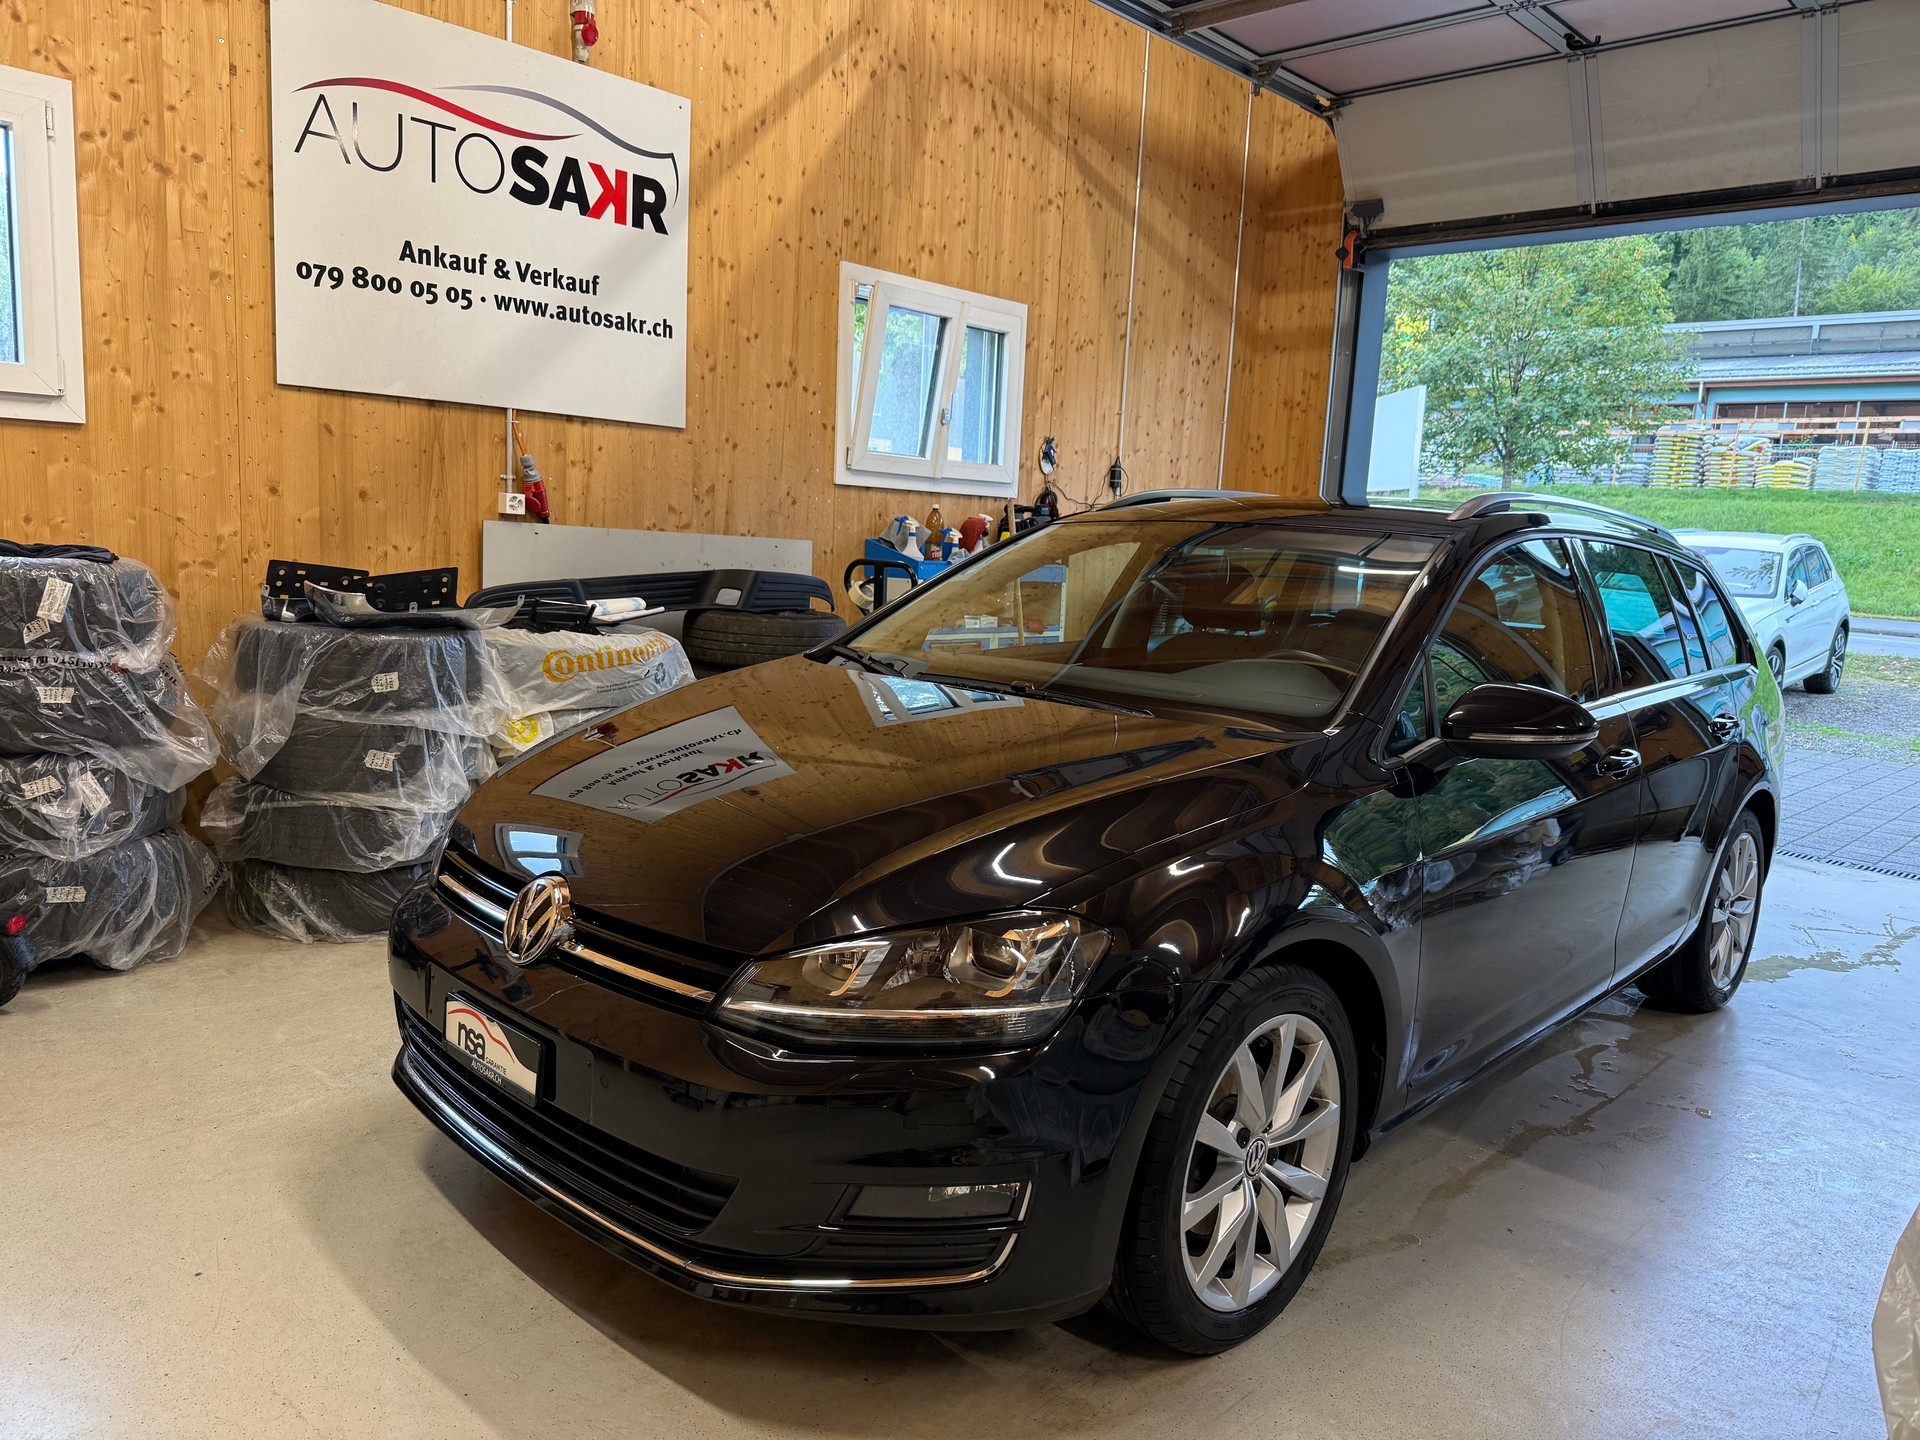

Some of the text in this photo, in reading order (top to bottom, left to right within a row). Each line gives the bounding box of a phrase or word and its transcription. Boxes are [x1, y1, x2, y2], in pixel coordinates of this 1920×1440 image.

[294, 93, 669, 236] AUTOSAKR
[399, 239, 601, 297] Ankauf & Verkauf
[295, 261, 345, 290] 079
[351, 266, 403, 295] 800
[409, 280, 439, 305] 05
[445, 286, 473, 311] 05
[493, 294, 673, 340] www.autosakr.ch
[541, 632, 673, 683] Continental
[457, 1021, 486, 1062] nsa
[485, 1056, 507, 1076] GARANTIE
[470, 1059, 502, 1085] AUTOSAKR.CH
